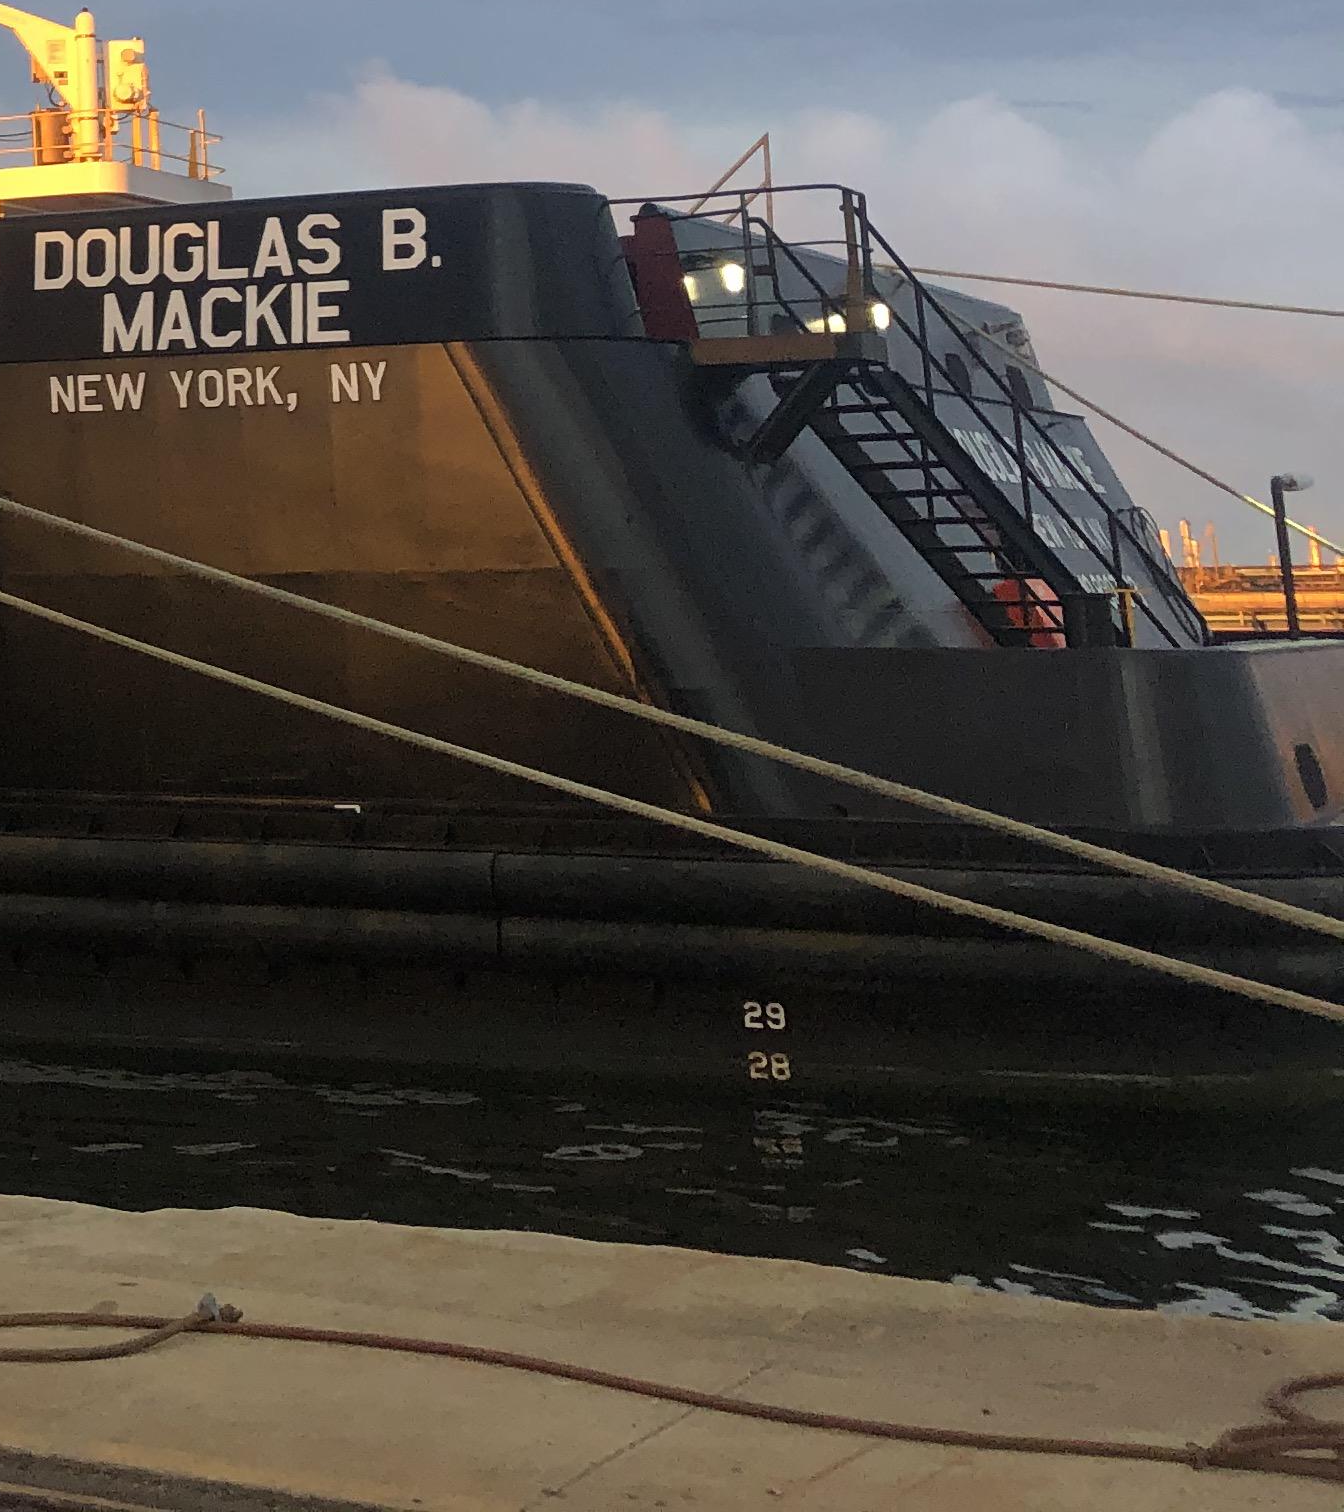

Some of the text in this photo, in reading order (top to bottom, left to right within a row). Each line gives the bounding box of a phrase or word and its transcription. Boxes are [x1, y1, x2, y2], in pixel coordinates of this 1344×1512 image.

[33, 208, 442, 291] DOUGLAS B.
[102, 280, 350, 353] MACKIE
[49, 361, 387, 414] NEW YORK, NY
[743, 1000, 786, 1030] 29
[747, 1051, 792, 1081] 28
